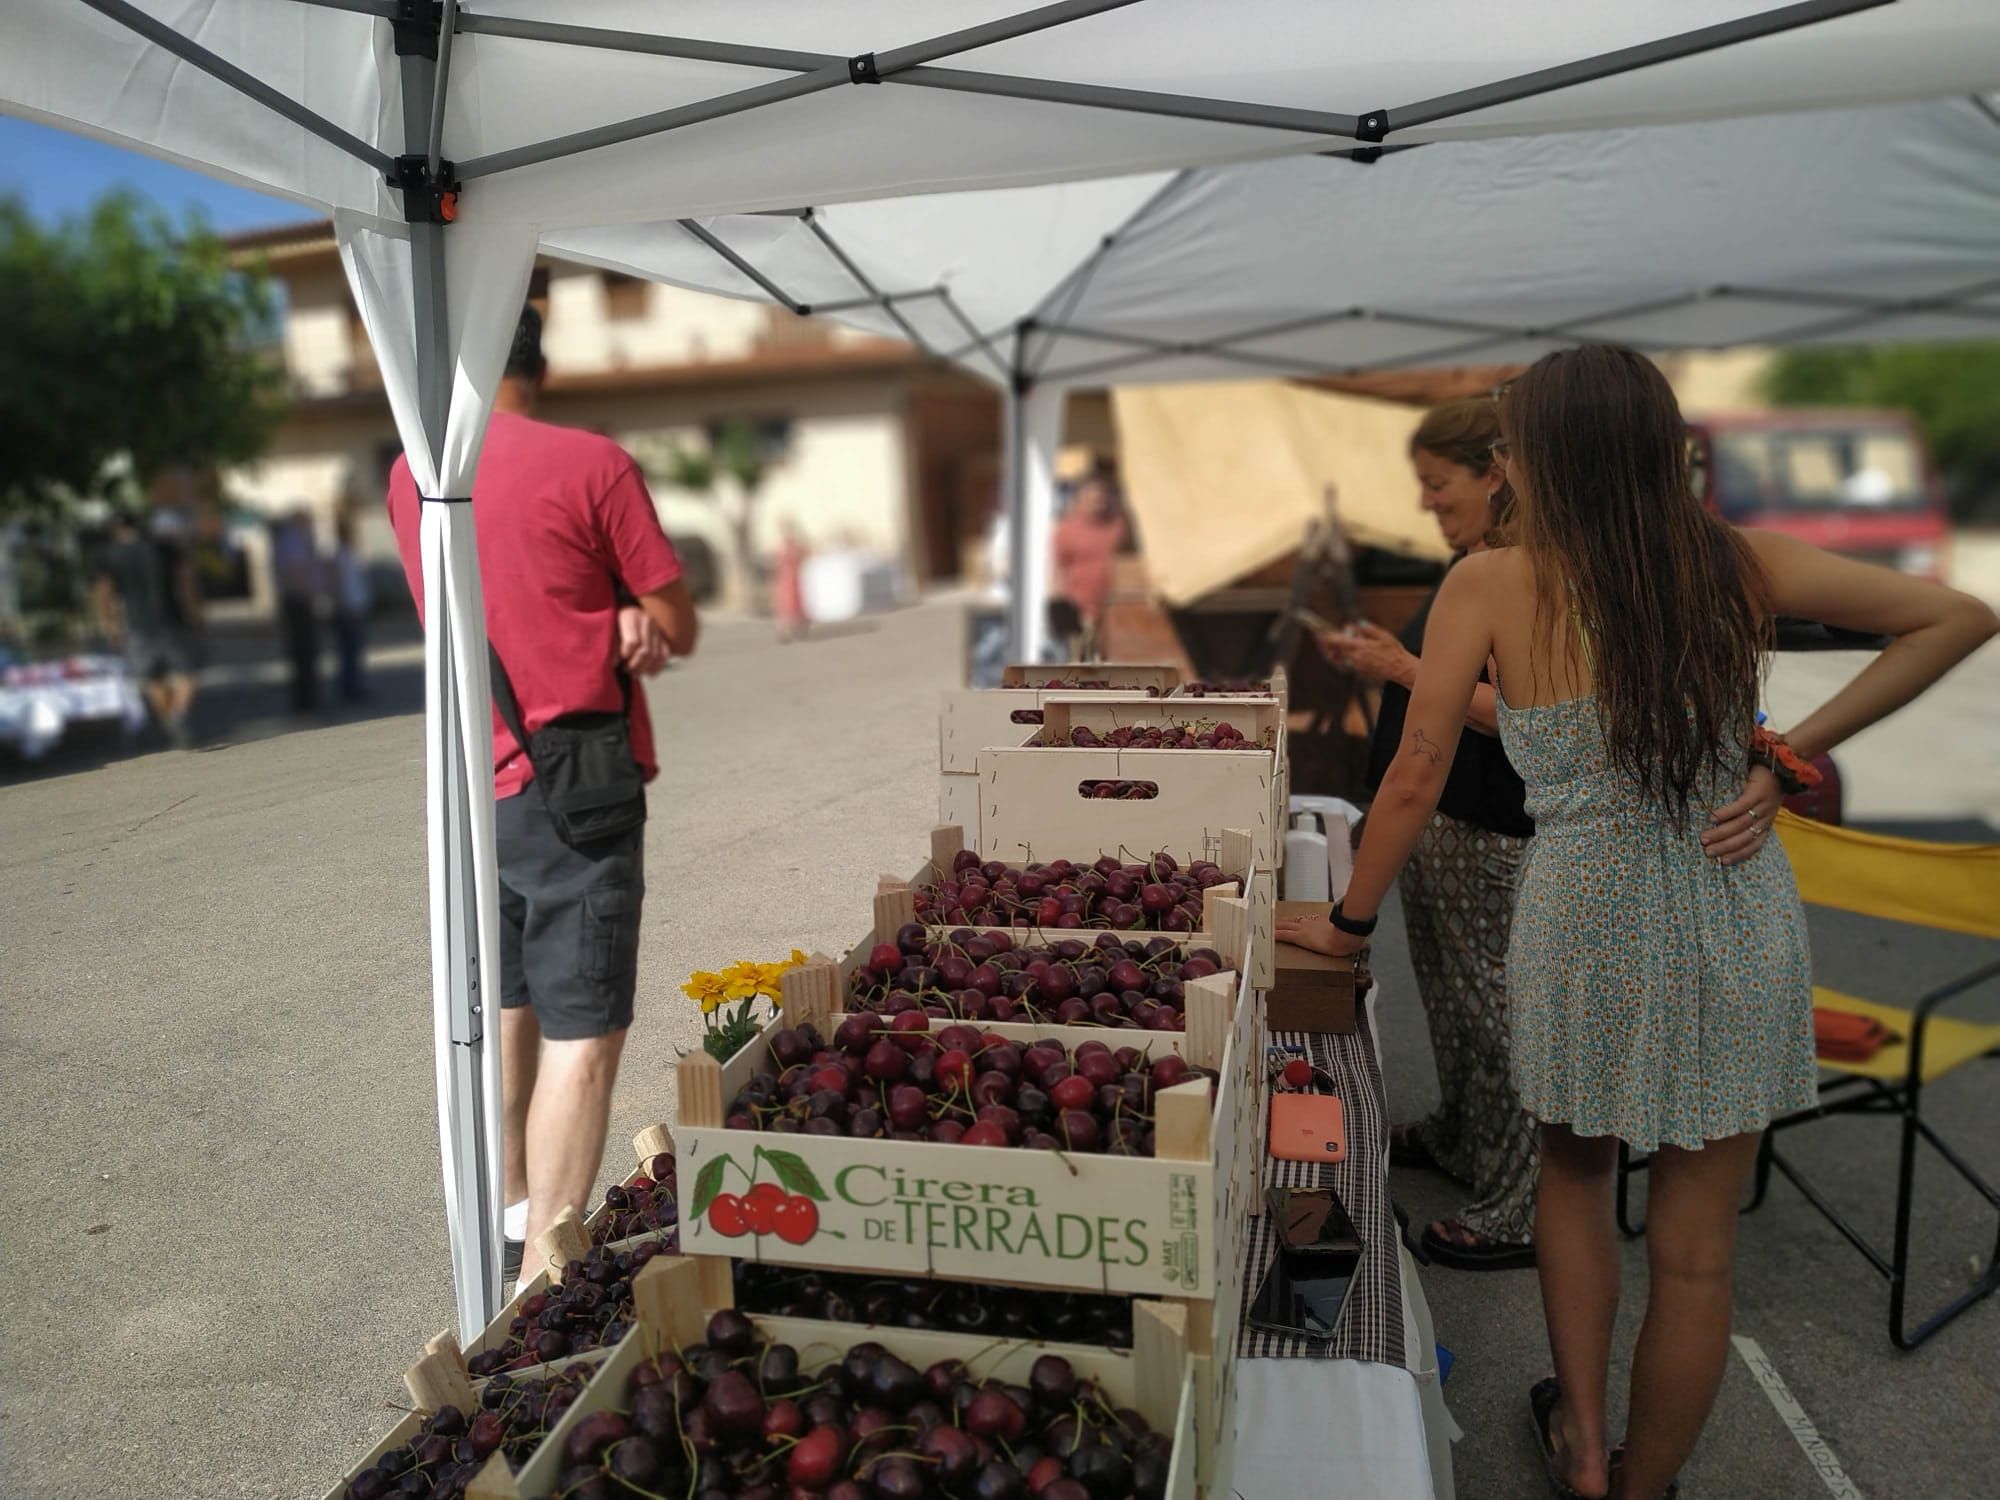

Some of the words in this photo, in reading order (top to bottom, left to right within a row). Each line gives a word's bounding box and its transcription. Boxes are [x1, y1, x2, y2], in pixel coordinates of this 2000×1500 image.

[834, 1164, 1041, 1207] Cirera
[864, 1218, 896, 1242] DE
[893, 1199, 1149, 1267] TERRADES
